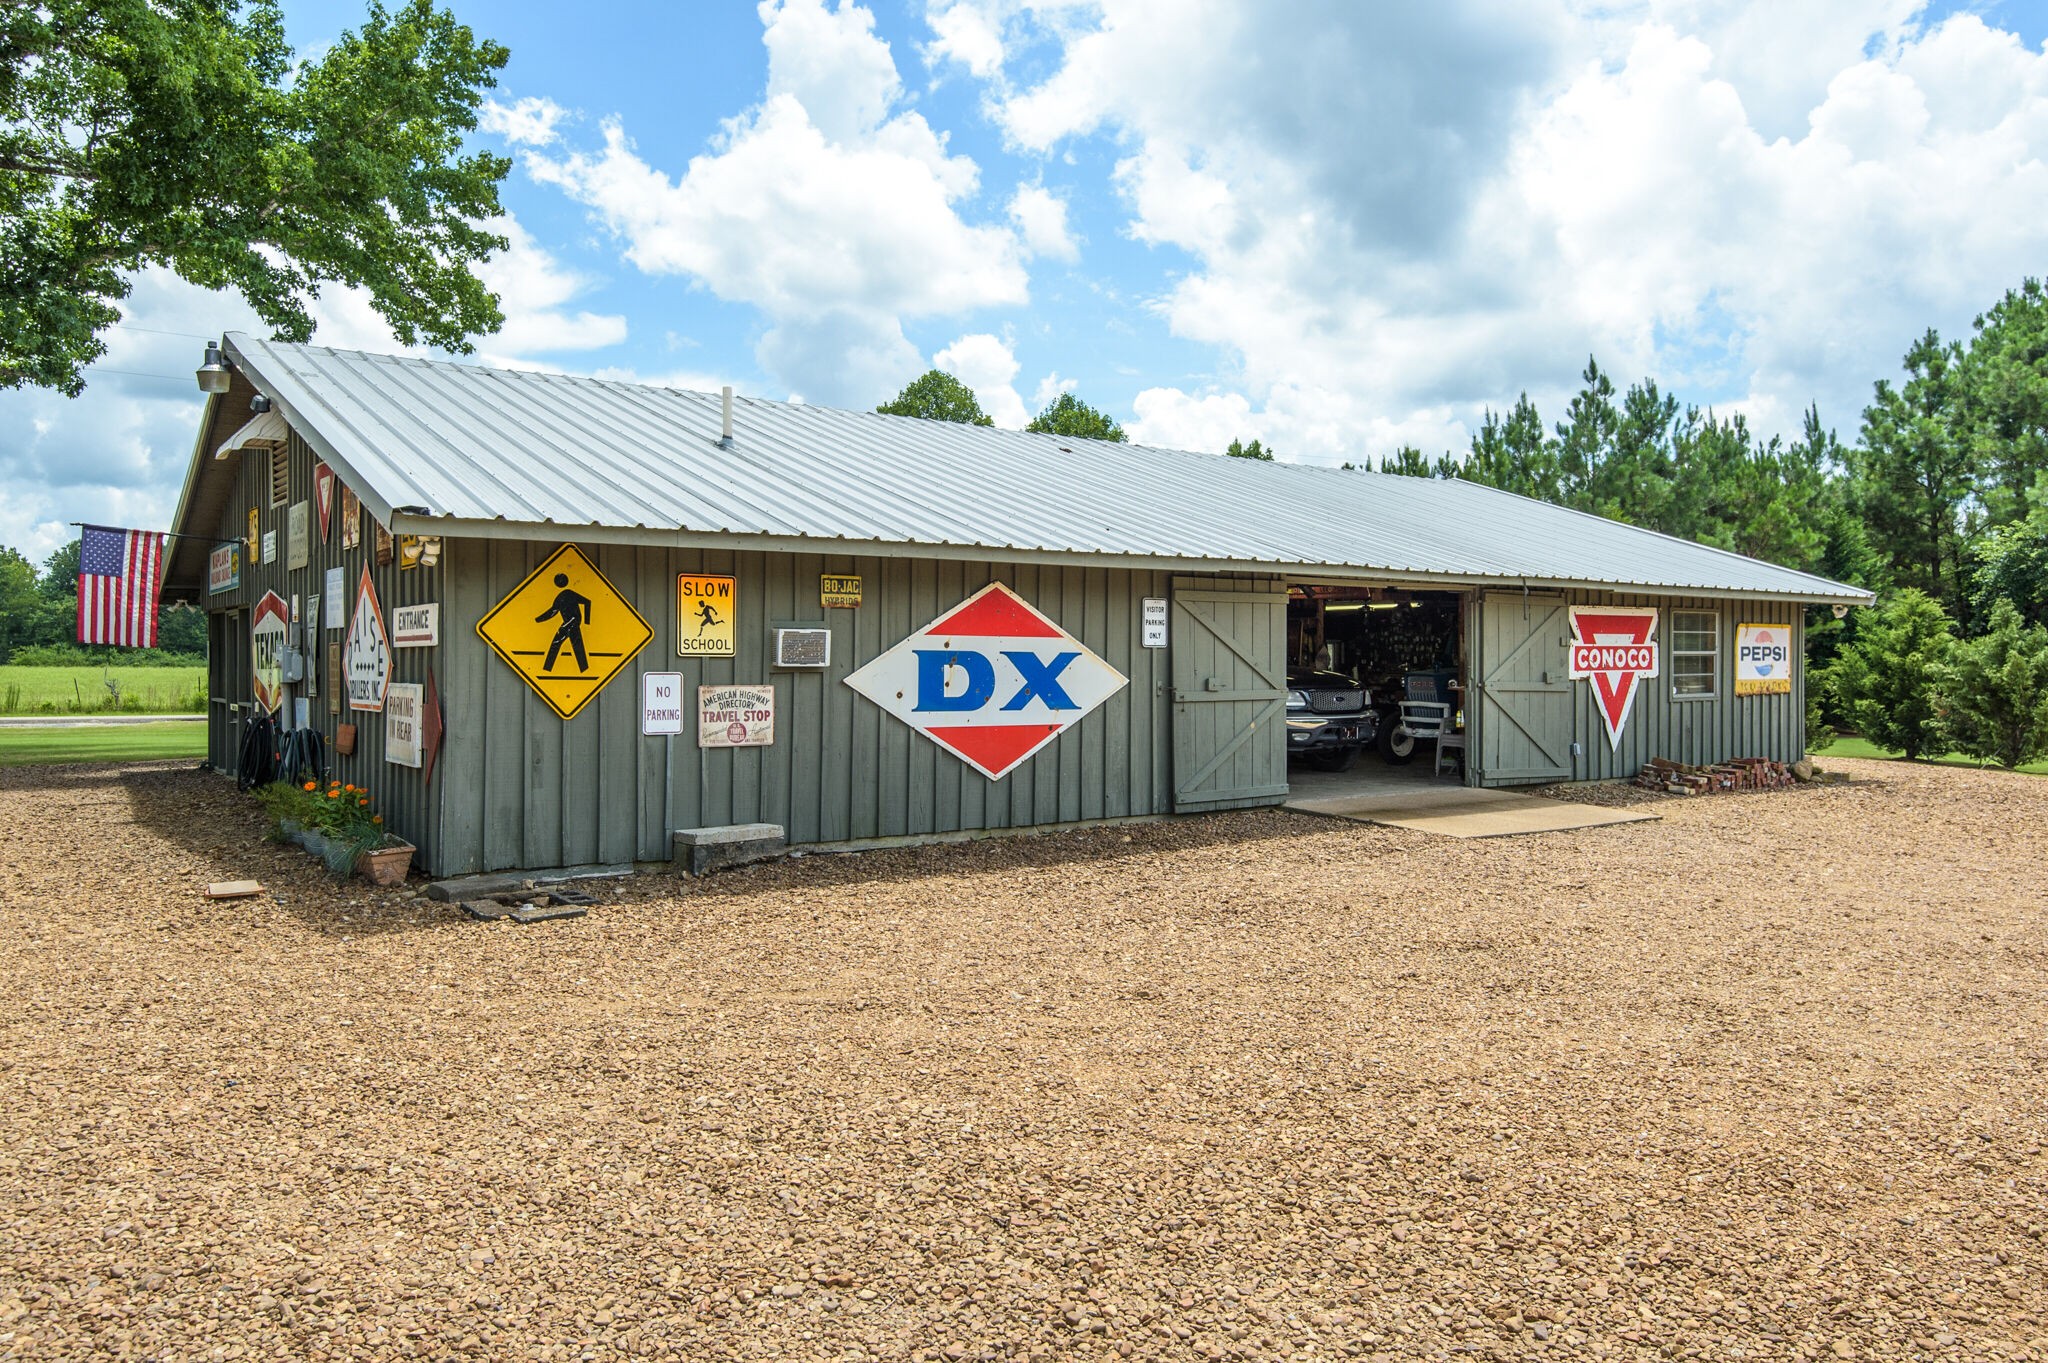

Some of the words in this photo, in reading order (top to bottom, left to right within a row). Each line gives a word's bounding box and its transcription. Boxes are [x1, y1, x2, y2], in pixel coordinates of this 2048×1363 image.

[683, 582, 730, 597] SLOW
[398, 609, 430, 631] ENTRANCE
[683, 639, 731, 650] SCHOOL
[1577, 648, 1650, 669] CONOCO
[1740, 646, 1787, 662] PEPSI
[911, 650, 1083, 712] DX
[656, 686, 671, 698] NO
[703, 690, 737, 708] AMERICAN
[739, 690, 770, 706] HIGHWAY
[388, 696, 414, 718] PARKING
[718, 699, 756, 710] DIRECTORY
[647, 709, 680, 721] PARKING
[702, 711, 740, 723] TRAVEL
[743, 710, 771, 722] STOP
[388, 720, 396, 739] IN
[397, 720, 412, 742] REAR
